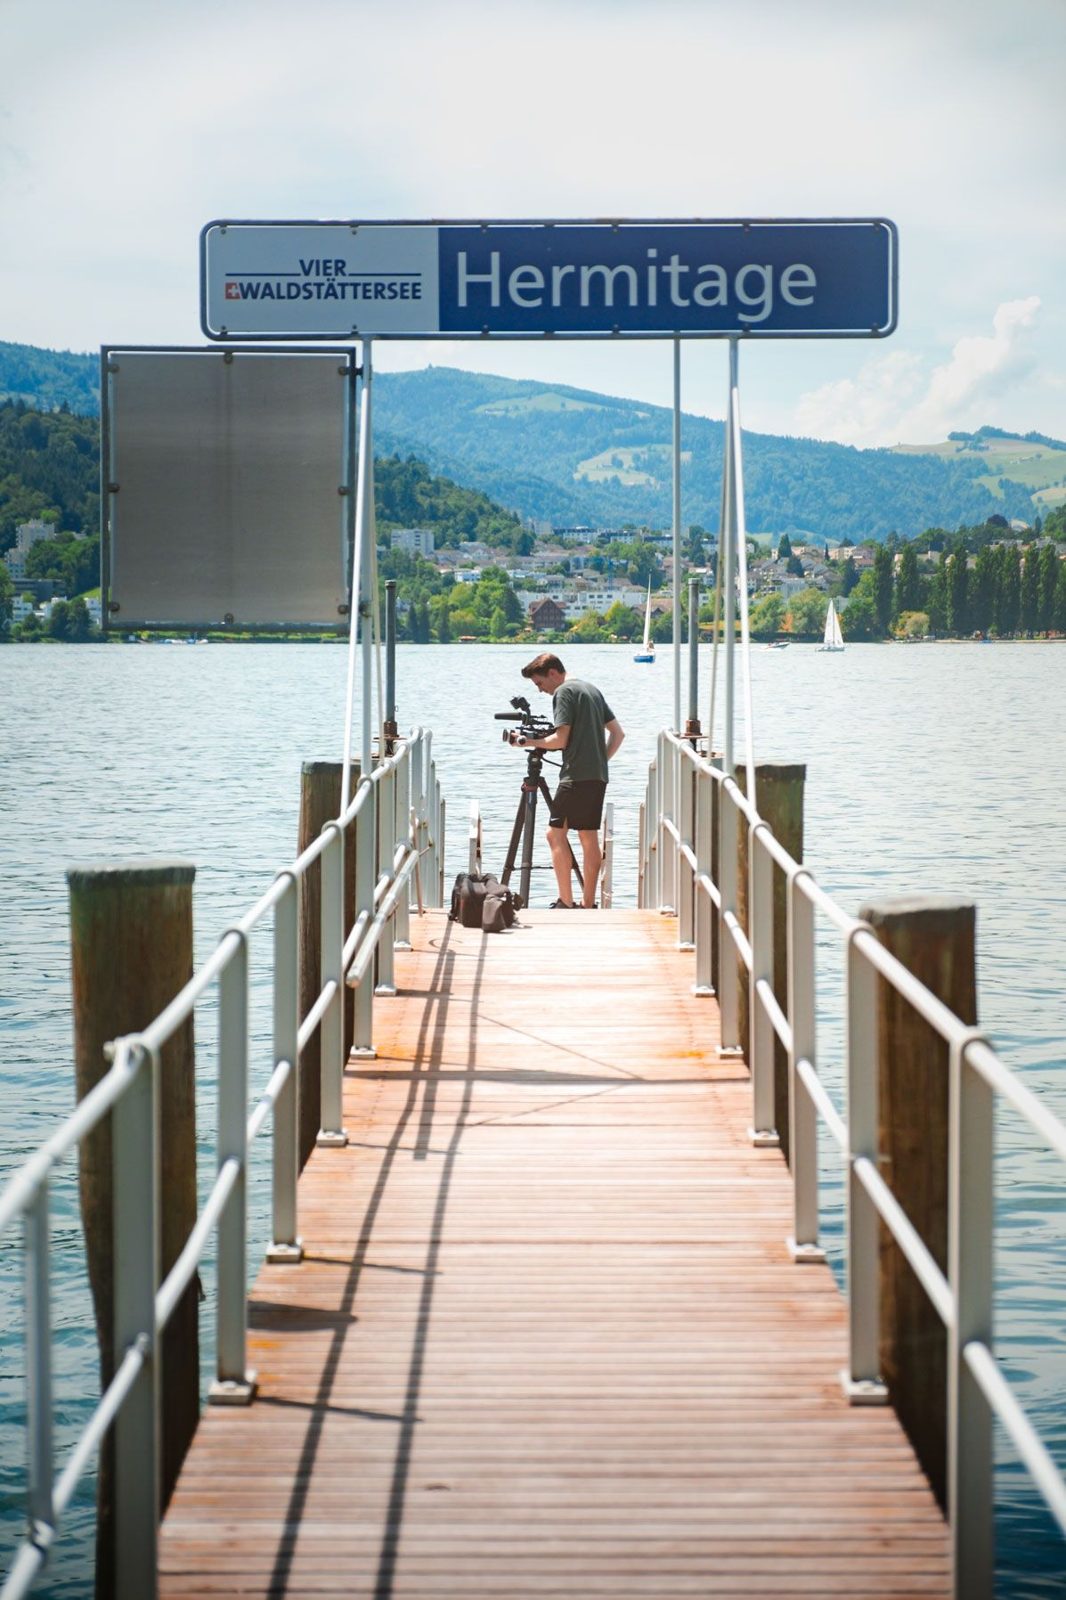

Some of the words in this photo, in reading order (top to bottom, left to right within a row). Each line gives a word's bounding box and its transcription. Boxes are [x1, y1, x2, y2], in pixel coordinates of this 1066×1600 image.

[299, 259, 347, 277] VIER
[240, 278, 422, 300] WALDSTÄTTERSEE
[457, 248, 817, 323] Hermitage
